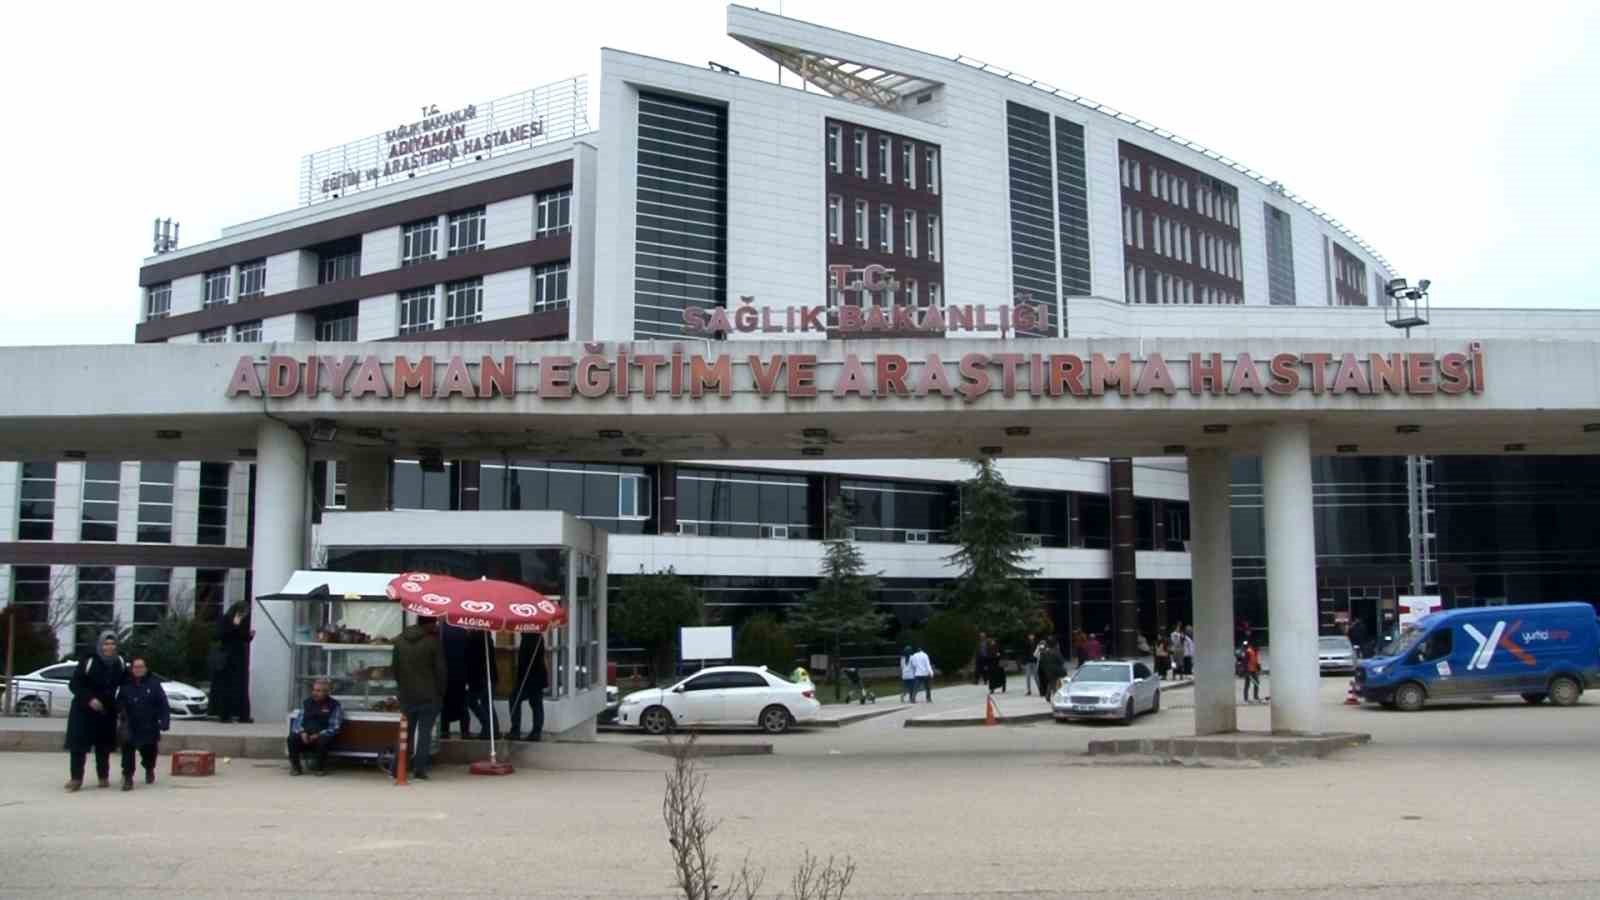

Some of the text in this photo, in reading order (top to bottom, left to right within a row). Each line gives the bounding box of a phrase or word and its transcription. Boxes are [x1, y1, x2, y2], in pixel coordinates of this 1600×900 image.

[388, 123, 466, 158] ADIYAMAN
[463, 115, 544, 155] HASTANESİ
[683, 293, 1049, 332] SAĞLIK BAKANLIĞI
[226, 340, 1485, 404] ADIYAMAN EĞİTİM VE ARAŞTIRMA HASTANESİ
[456, 616, 492, 628] ALGIDA
